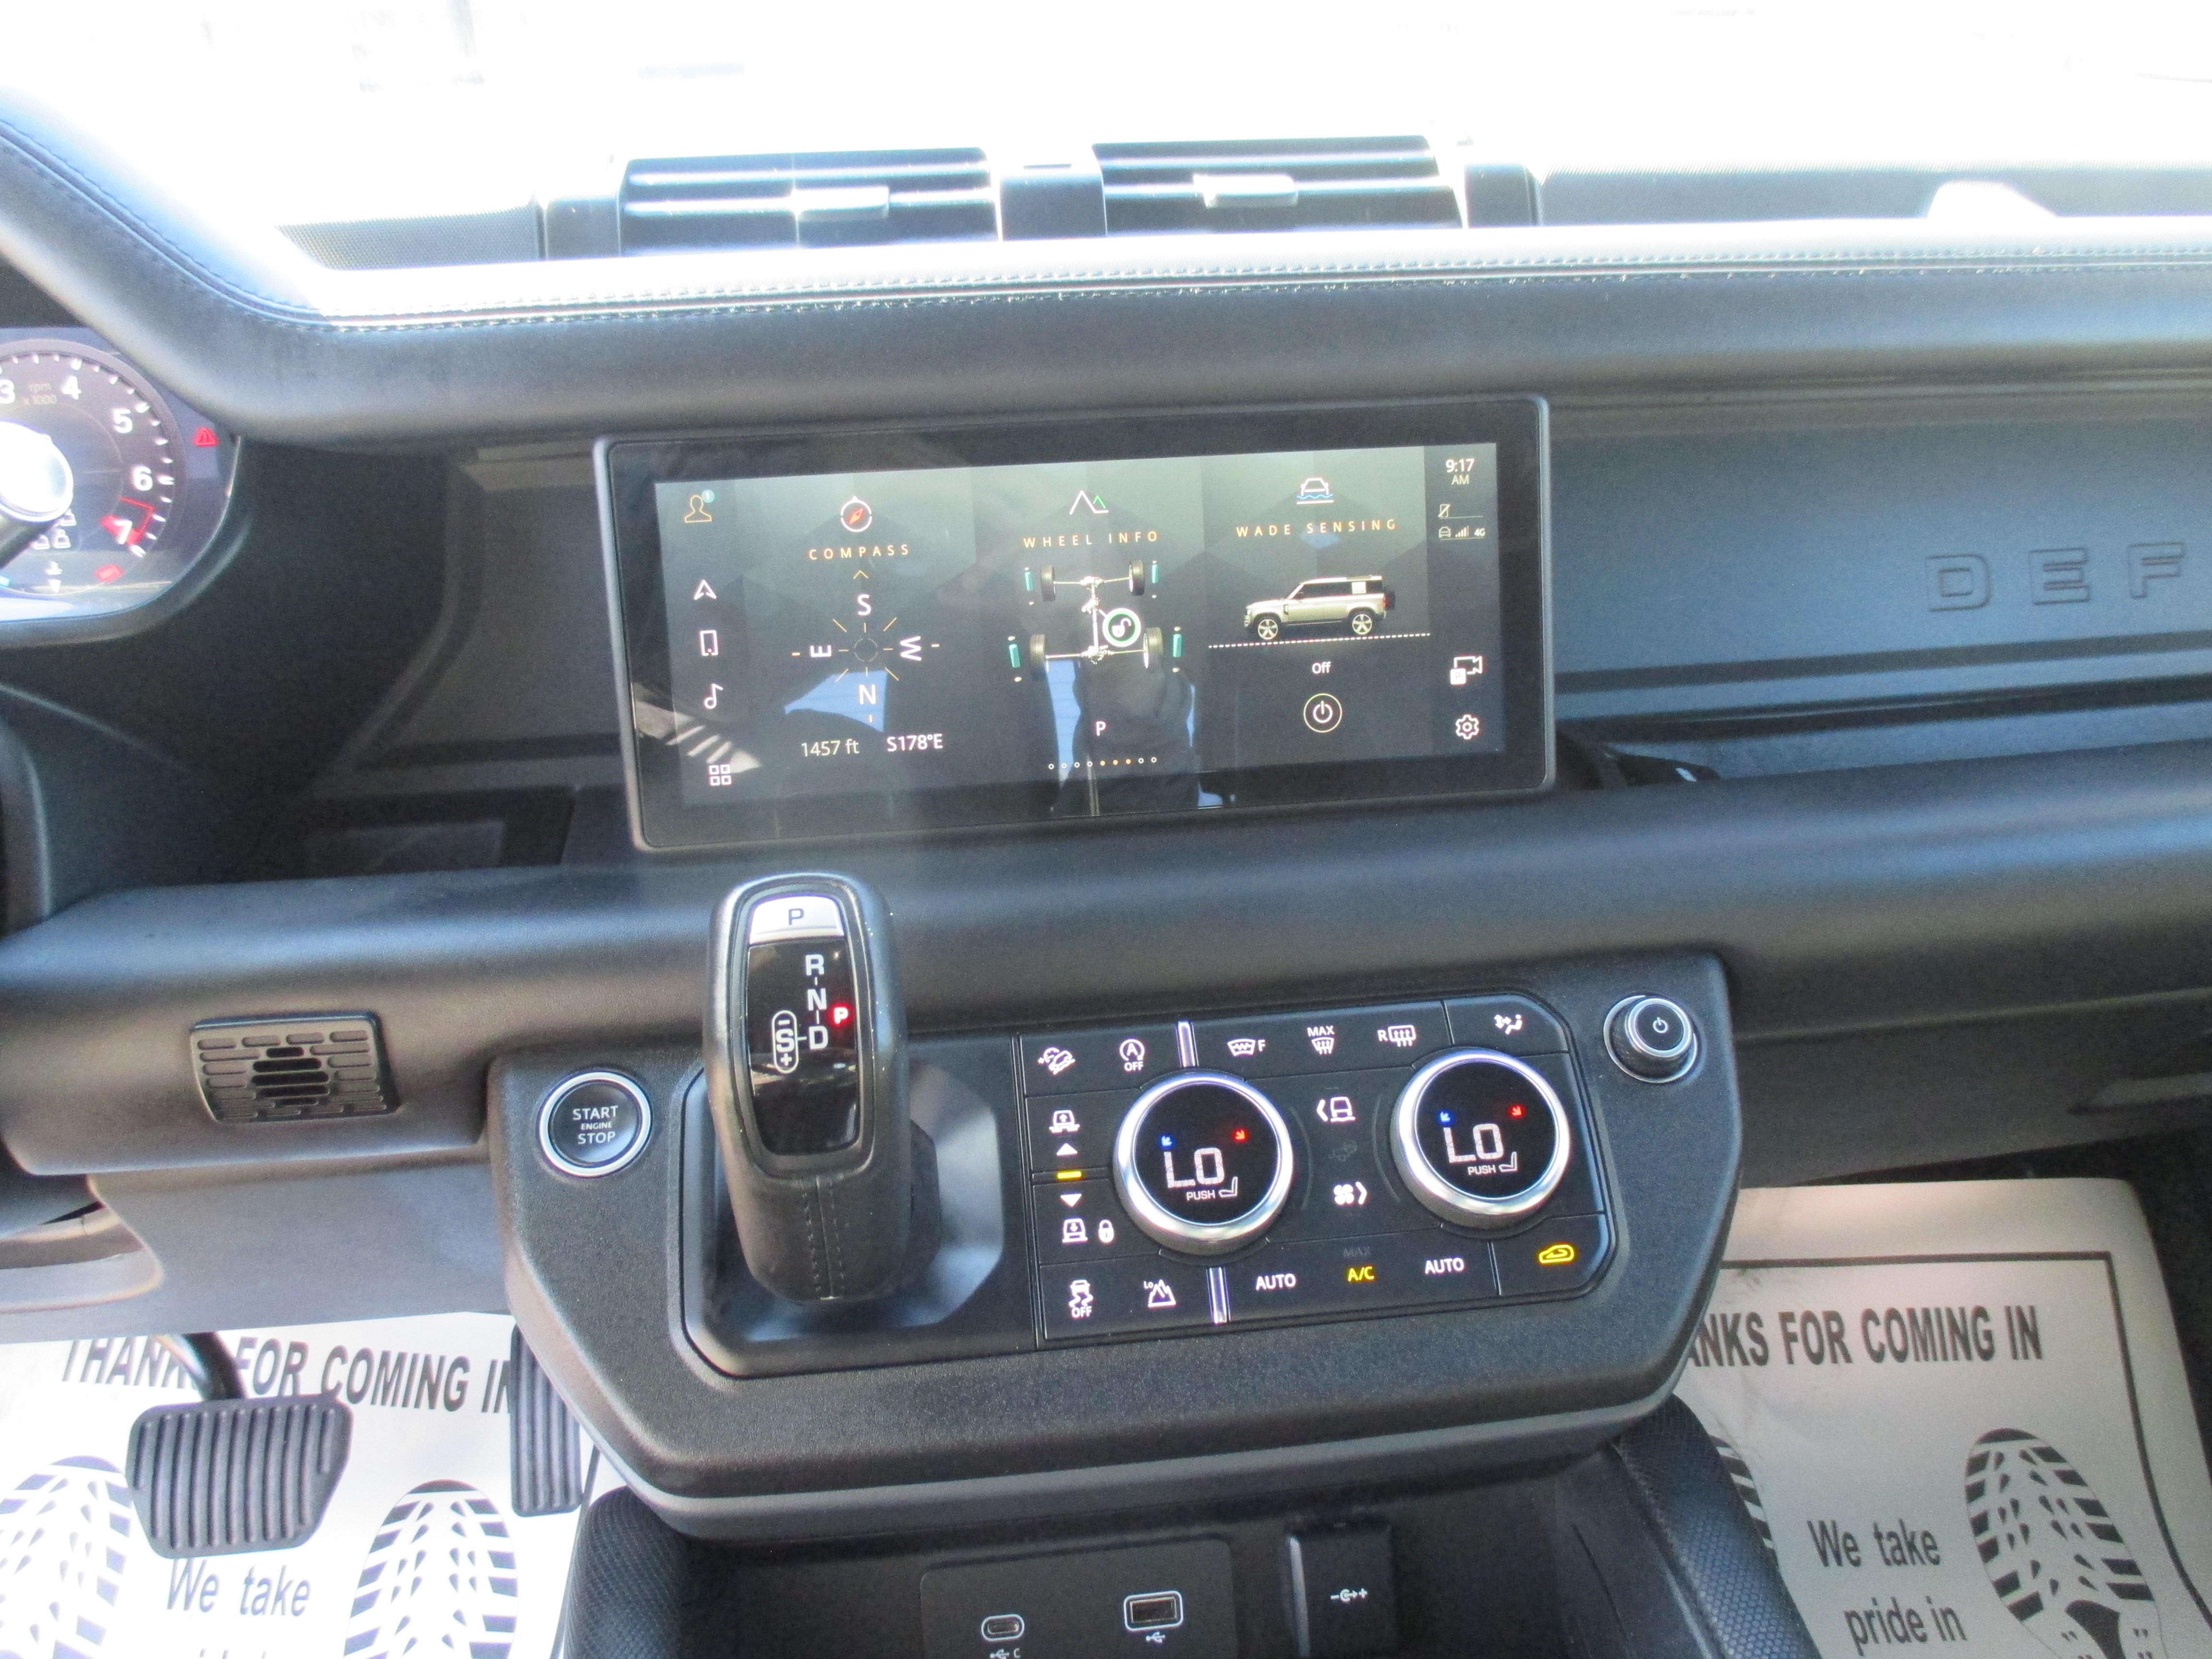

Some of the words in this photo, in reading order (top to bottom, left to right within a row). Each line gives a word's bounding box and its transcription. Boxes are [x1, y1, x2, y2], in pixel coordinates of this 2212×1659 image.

[0, 379, 15, 404] 3
[61, 375, 82, 400] 4
[113, 408, 133, 433] 5
[1445, 458, 1475, 473] 9:17
[132, 465, 154, 491] 6
[1451, 474, 1470, 485] AM
[113, 519, 133, 544] 7
[1236, 524, 1291, 537] WADE
[1306, 518, 1396, 534] SENSING
[1474, 528, 1486, 537] 4G
[1023, 533, 1092, 548] WHEEL
[1109, 531, 1158, 544] INFO
[809, 545, 909, 560] COMPASS
[1924, 541, 2186, 613] DEF
[857, 593, 872, 616] S
[1311, 661, 1331, 674] Off
[859, 684, 877, 705] N
[1096, 721, 1106, 736] P
[801, 741, 840, 757] 1457
[845, 738, 860, 755] ft
[887, 733, 943, 752] S178°E
[788, 908, 805, 926] P
[805, 954, 825, 976] R
[807, 988, 827, 1011] N
[834, 1007, 849, 1024] P
[808, 1025, 829, 1050] D
[1307, 1025, 1335, 1037] MAX
[1378, 1029, 1388, 1042] R
[776, 1028, 795, 1052] S
[1258, 1039, 1266, 1052] F
[1124, 1061, 1144, 1071] OFF
[573, 1105, 618, 1120] START
[581, 1121, 613, 1130] ENGINE
[577, 1131, 616, 1144] STOP
[1467, 1164, 1497, 1175] PUSH
[1186, 1189, 1216, 1201] PUSH
[1348, 1266, 1375, 1281] A/C
[1425, 1257, 1465, 1274] AUTO
[1255, 1273, 1297, 1290] AUTO
[1071, 1306, 1093, 1318] OFF
[1778, 1310, 1853, 1365] FOR
[1861, 1305, 1996, 1363] COMING
[2004, 1305, 2043, 1360] IN
[62, 1335, 204, 1390] THANK
[234, 1336, 310, 1396] FOR
[321, 1345, 471, 1412] COMING
[1806, 1519, 1862, 1567] We
[1873, 1518, 1941, 1566] take
[167, 1558, 219, 1612] We
[240, 1565, 312, 1617] take
[1843, 1596, 1928, 1657] pride
[1925, 1595, 1967, 1641] in
